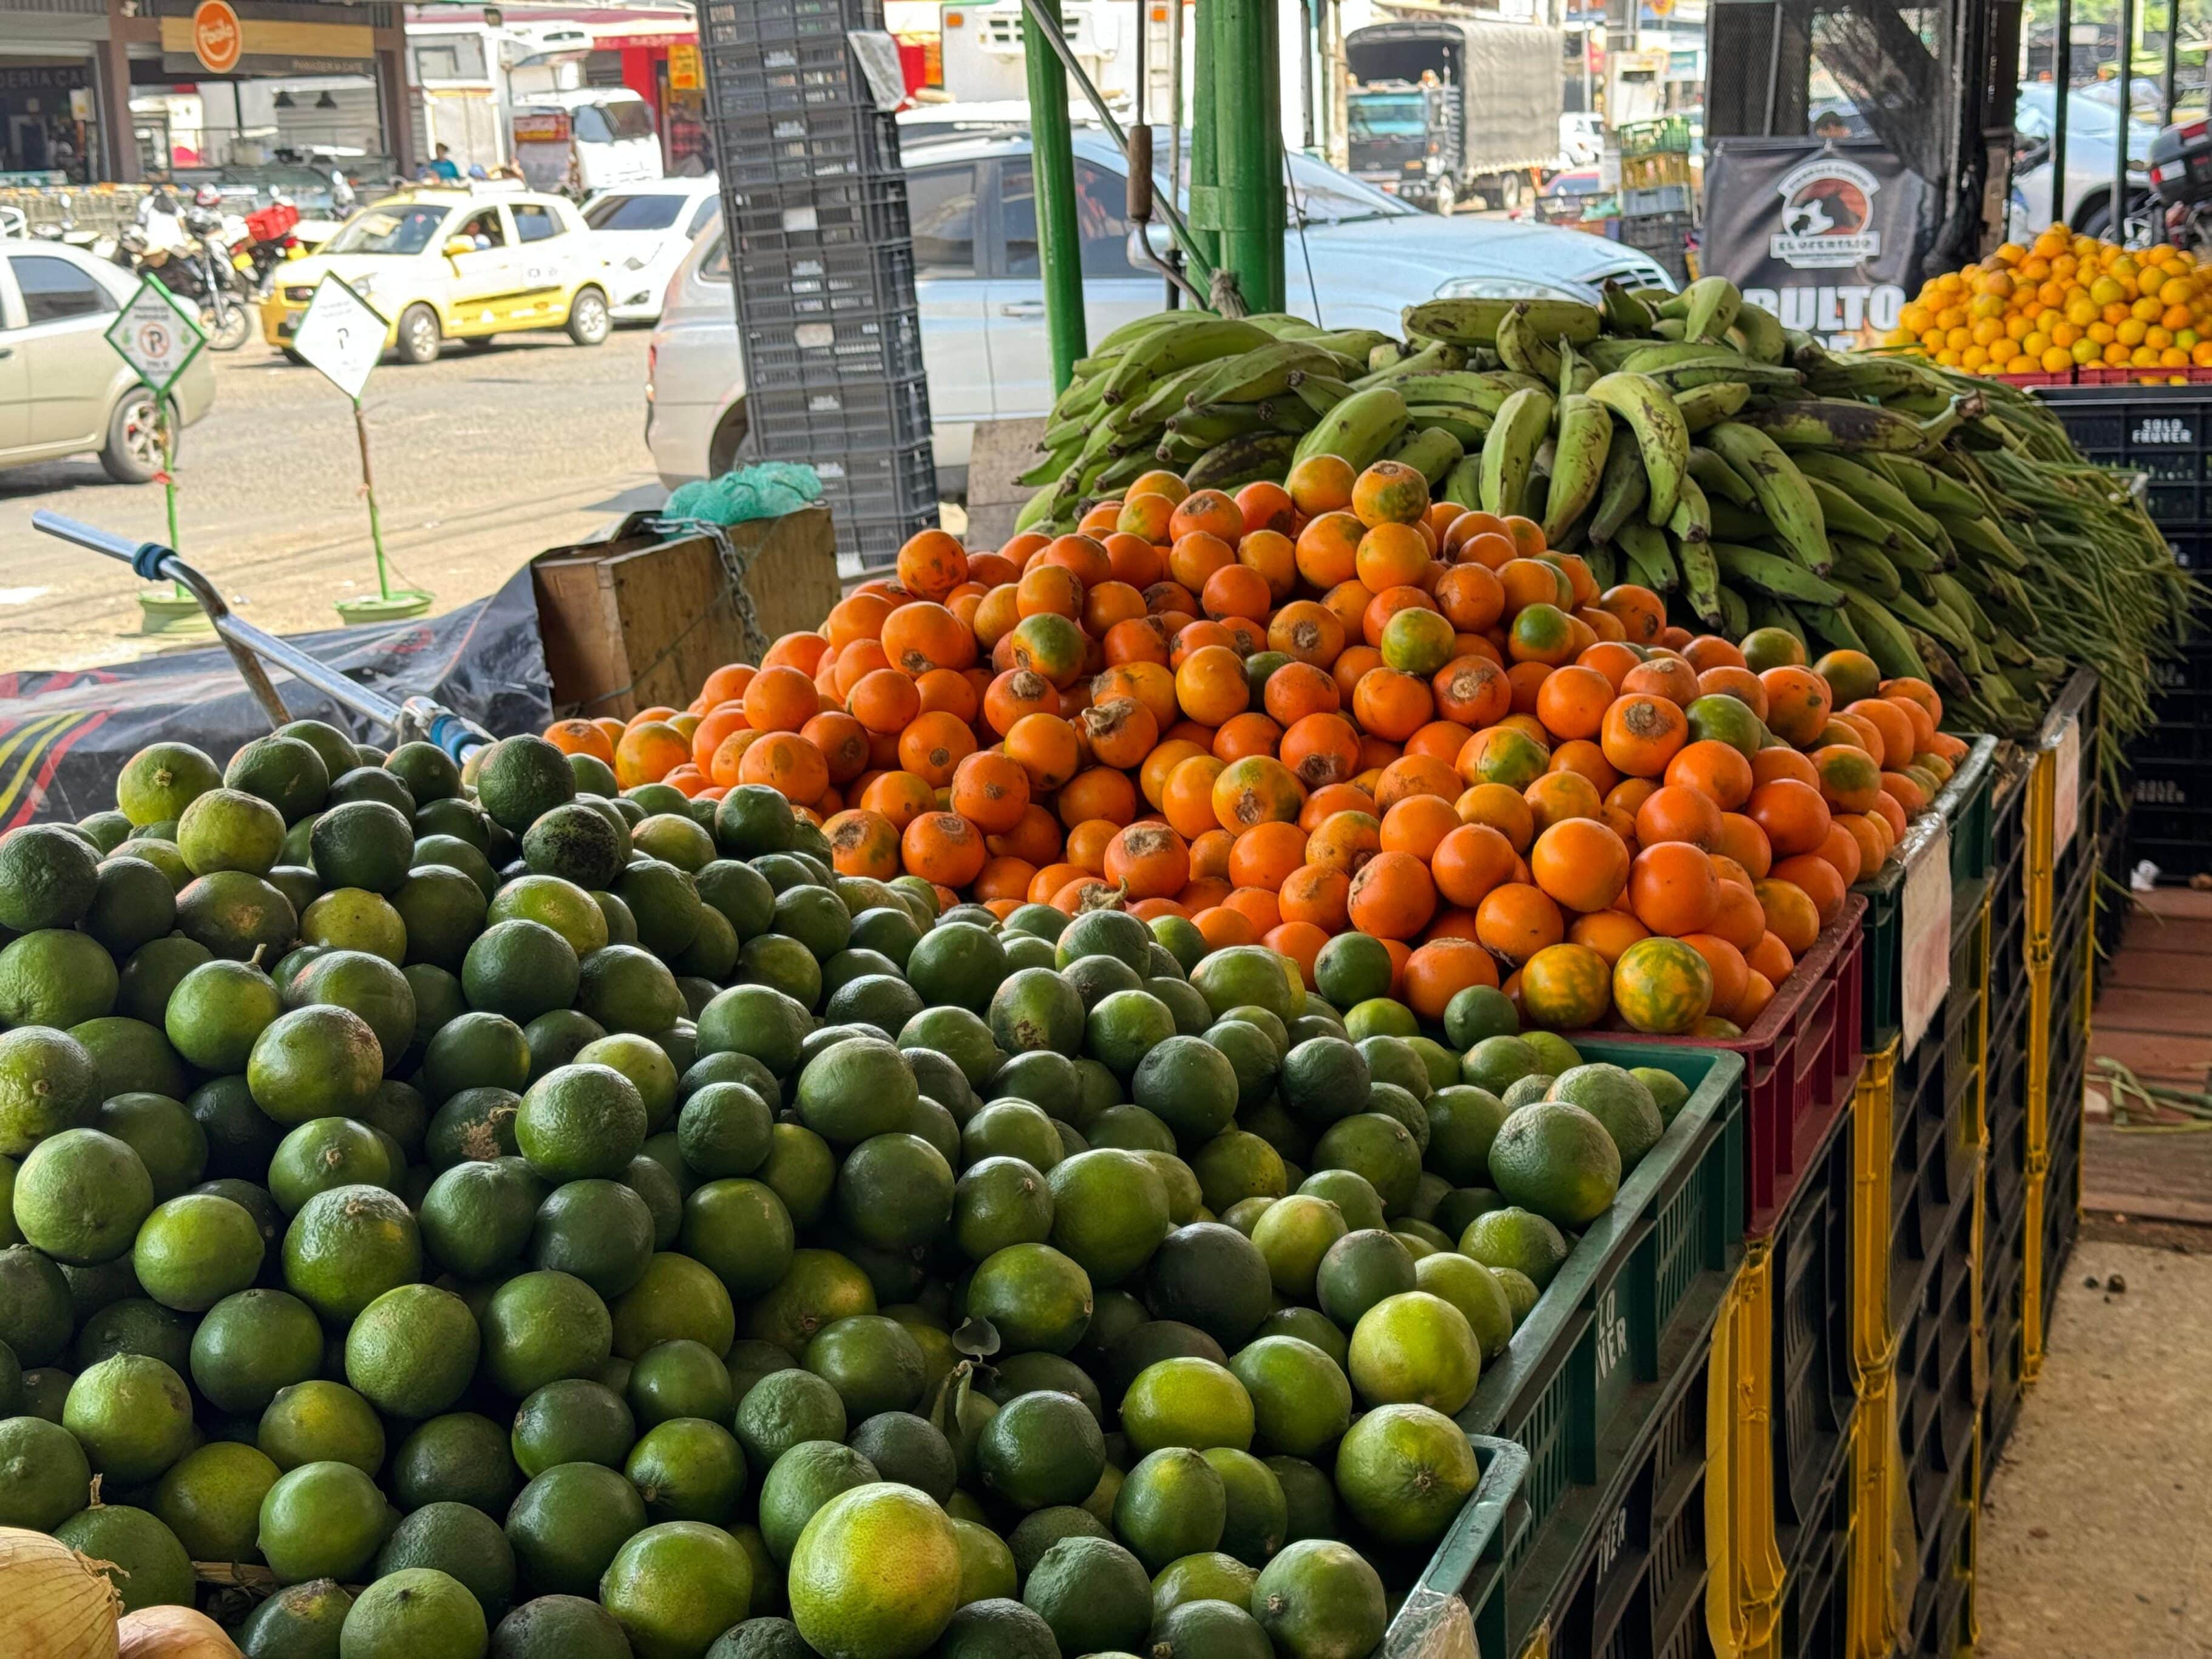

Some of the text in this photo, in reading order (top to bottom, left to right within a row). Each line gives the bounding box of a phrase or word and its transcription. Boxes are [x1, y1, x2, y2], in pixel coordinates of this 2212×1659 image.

[2142, 418, 2183, 432] SOLO
[2132, 429, 2191, 443] FRUVER
[2137, 790, 2185, 803] RUVER
[1596, 1317, 1627, 1389] VER
